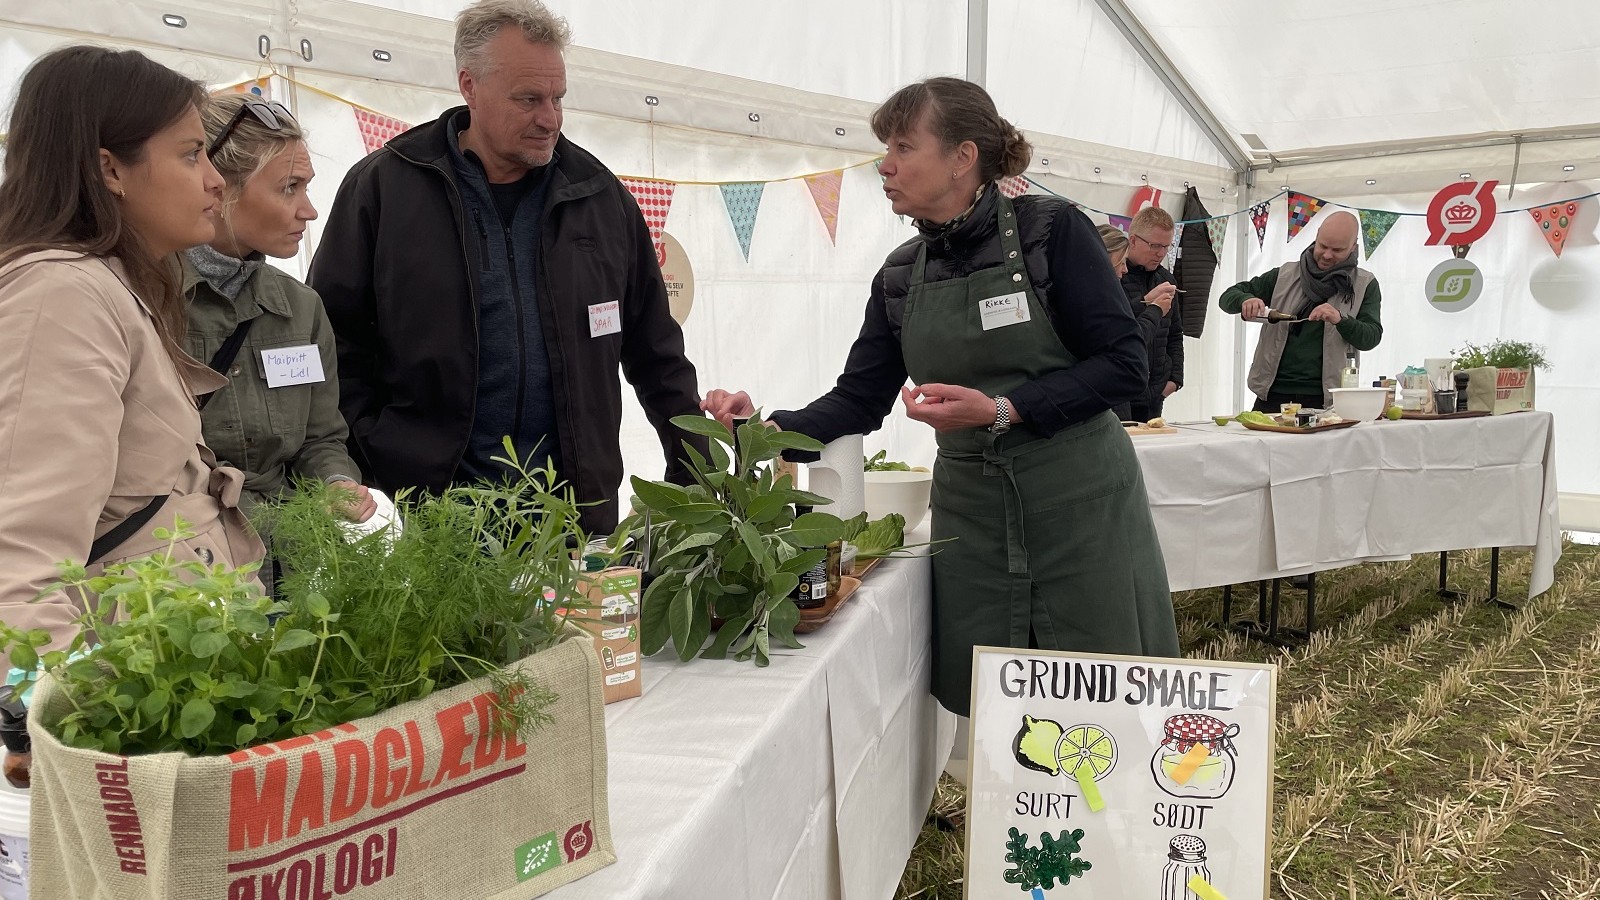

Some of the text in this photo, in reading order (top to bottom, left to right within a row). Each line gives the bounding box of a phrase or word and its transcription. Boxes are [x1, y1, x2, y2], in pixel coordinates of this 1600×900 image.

[267, 352, 307, 365] Maibritt
[290, 367, 309, 378] Lidl
[1000, 659, 1233, 711] GRUND SMAGE
[95, 757, 147, 876] RENMADGL
[1015, 791, 1078, 819] SURT
[1152, 802, 1213, 830] SØDT
